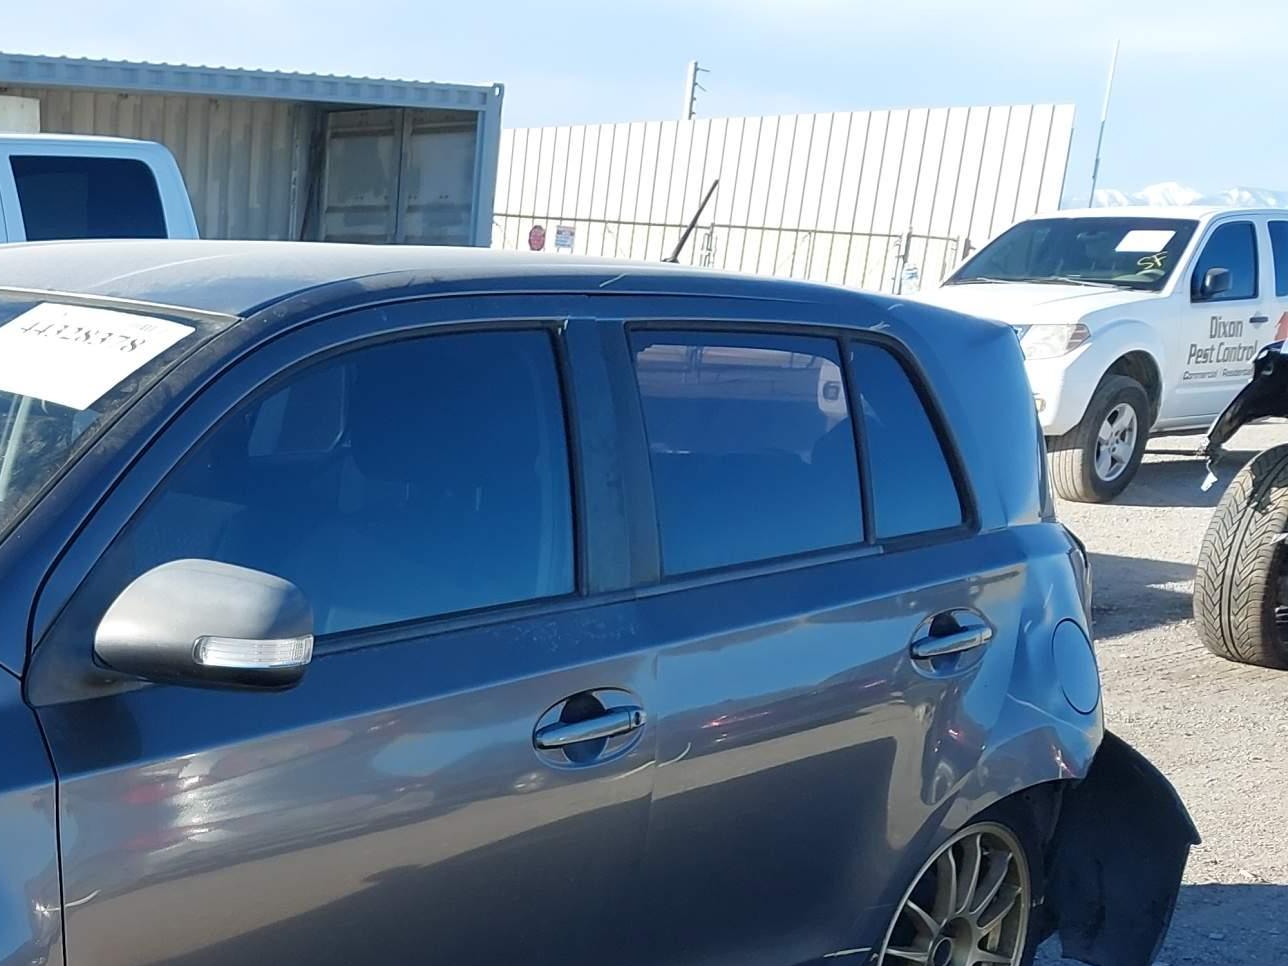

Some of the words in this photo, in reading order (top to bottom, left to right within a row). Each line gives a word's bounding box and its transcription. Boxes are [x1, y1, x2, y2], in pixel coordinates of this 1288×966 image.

[1209, 316, 1243, 338] Dixon
[1187, 343, 1215, 364] Pest
[1216, 340, 1258, 362] Control
